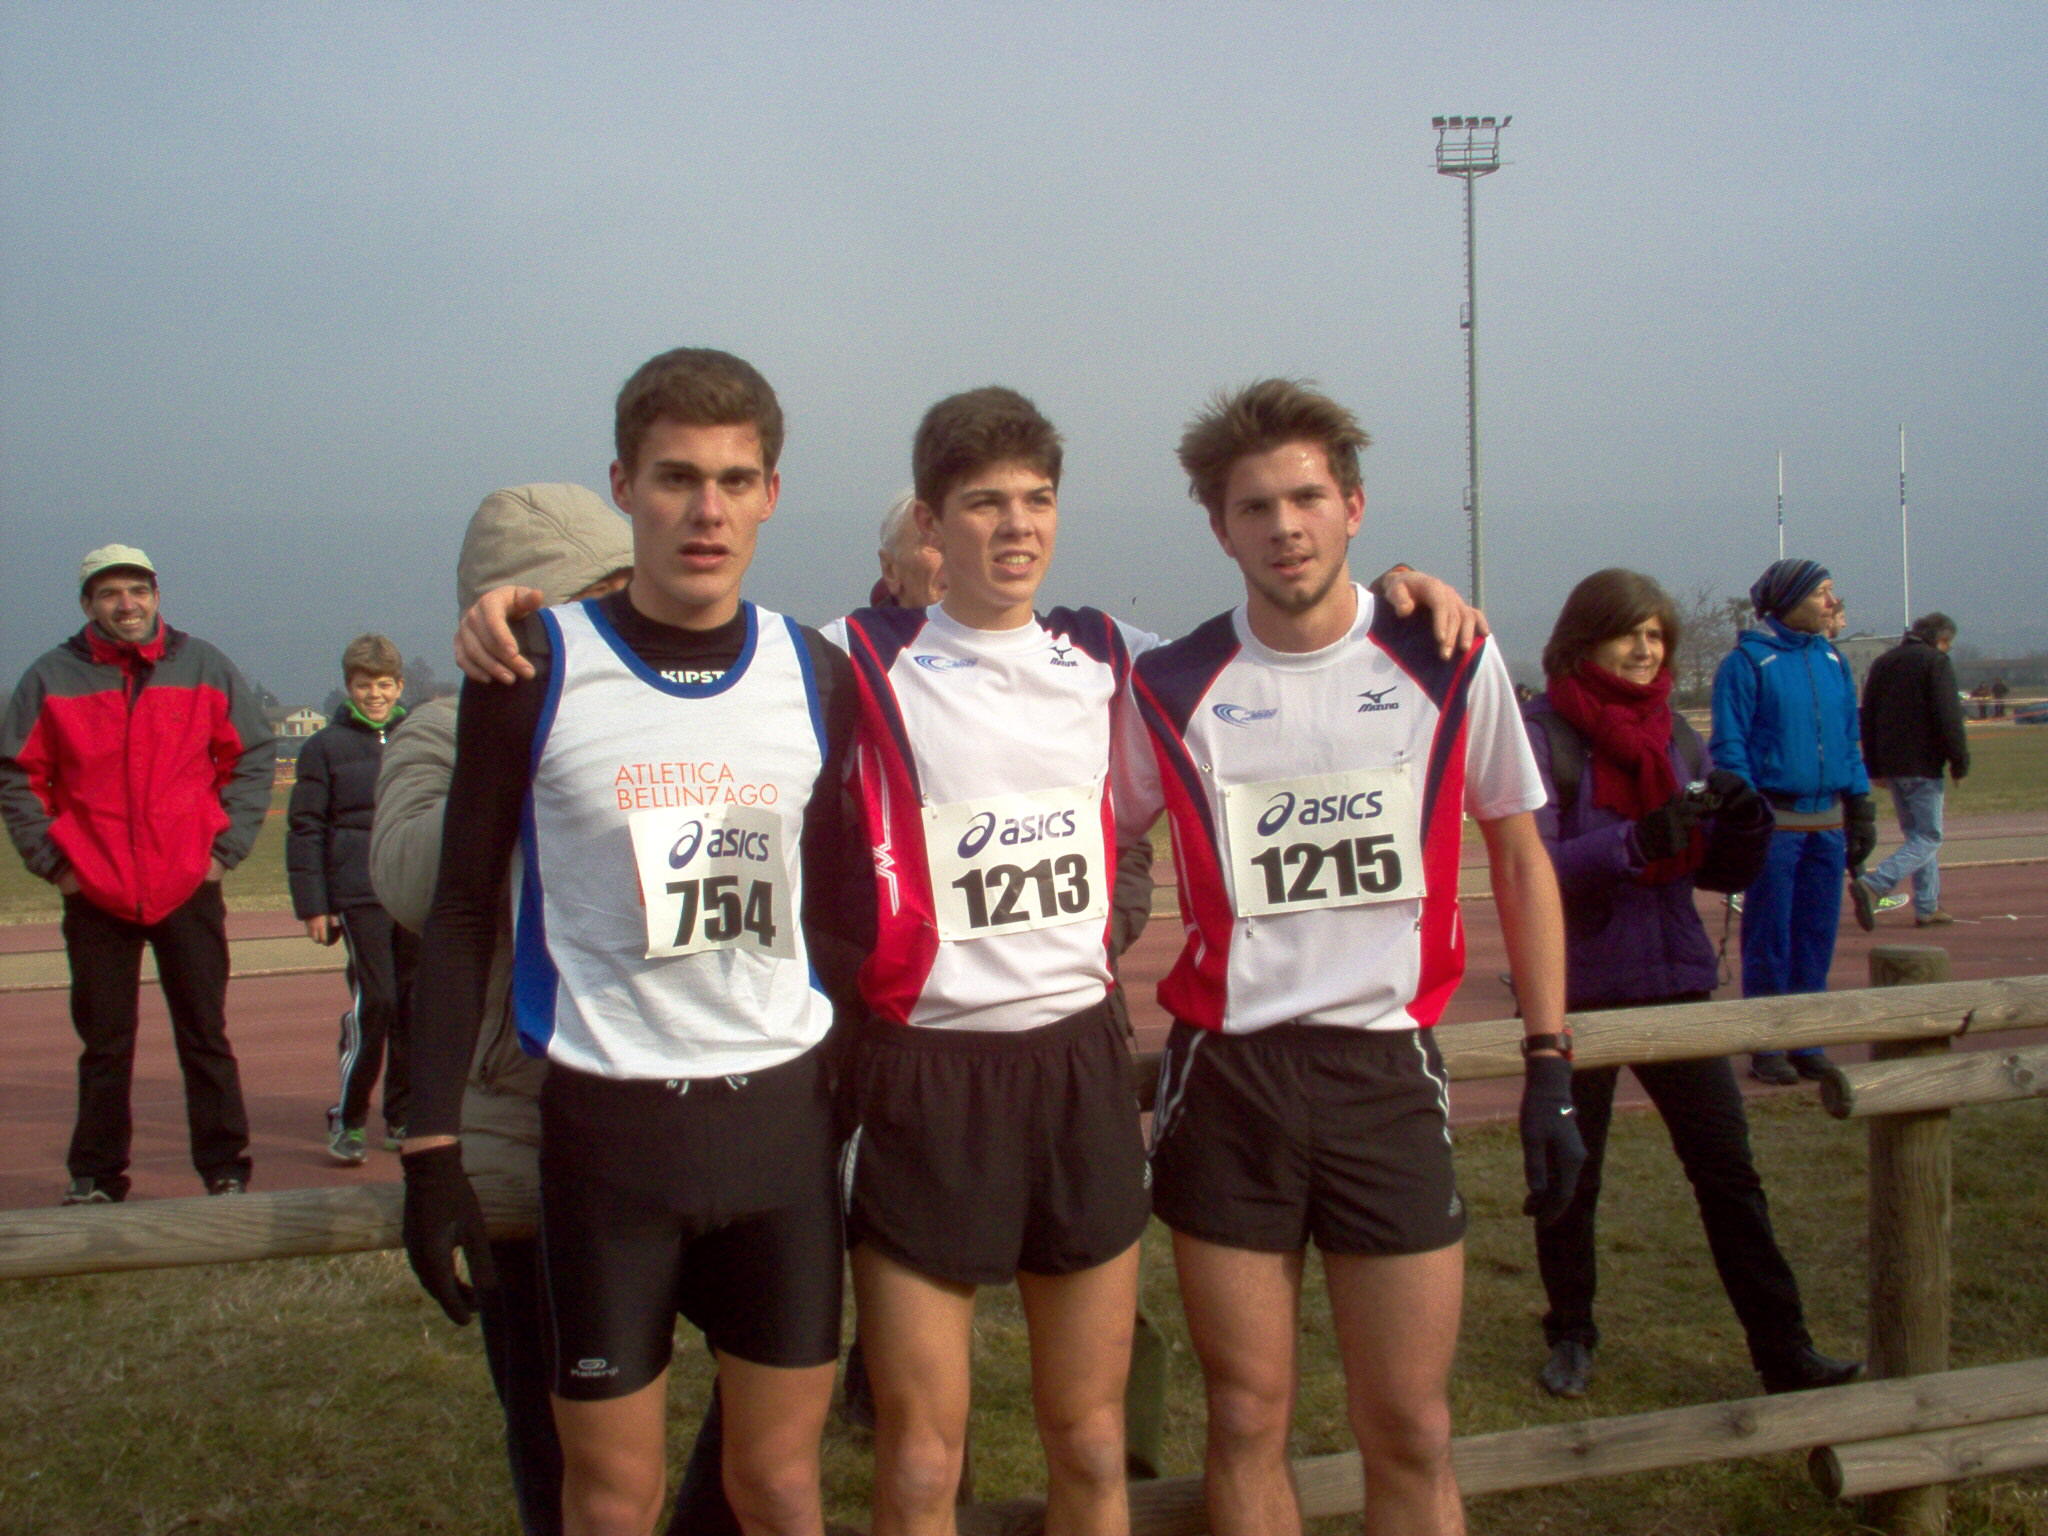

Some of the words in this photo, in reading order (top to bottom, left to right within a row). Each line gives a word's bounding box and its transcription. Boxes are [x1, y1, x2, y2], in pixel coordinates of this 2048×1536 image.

[660, 670, 726, 684] KIPST
[614, 762, 735, 786] ATLETICA
[615, 783, 778, 810] BELLINZAGO
[1298, 790, 1383, 826] asics
[706, 828, 770, 862] asics
[999, 809, 1076, 846] asics
[1250, 833, 1403, 905] 1215
[951, 853, 1090, 929] 1213
[665, 875, 777, 948] 754
